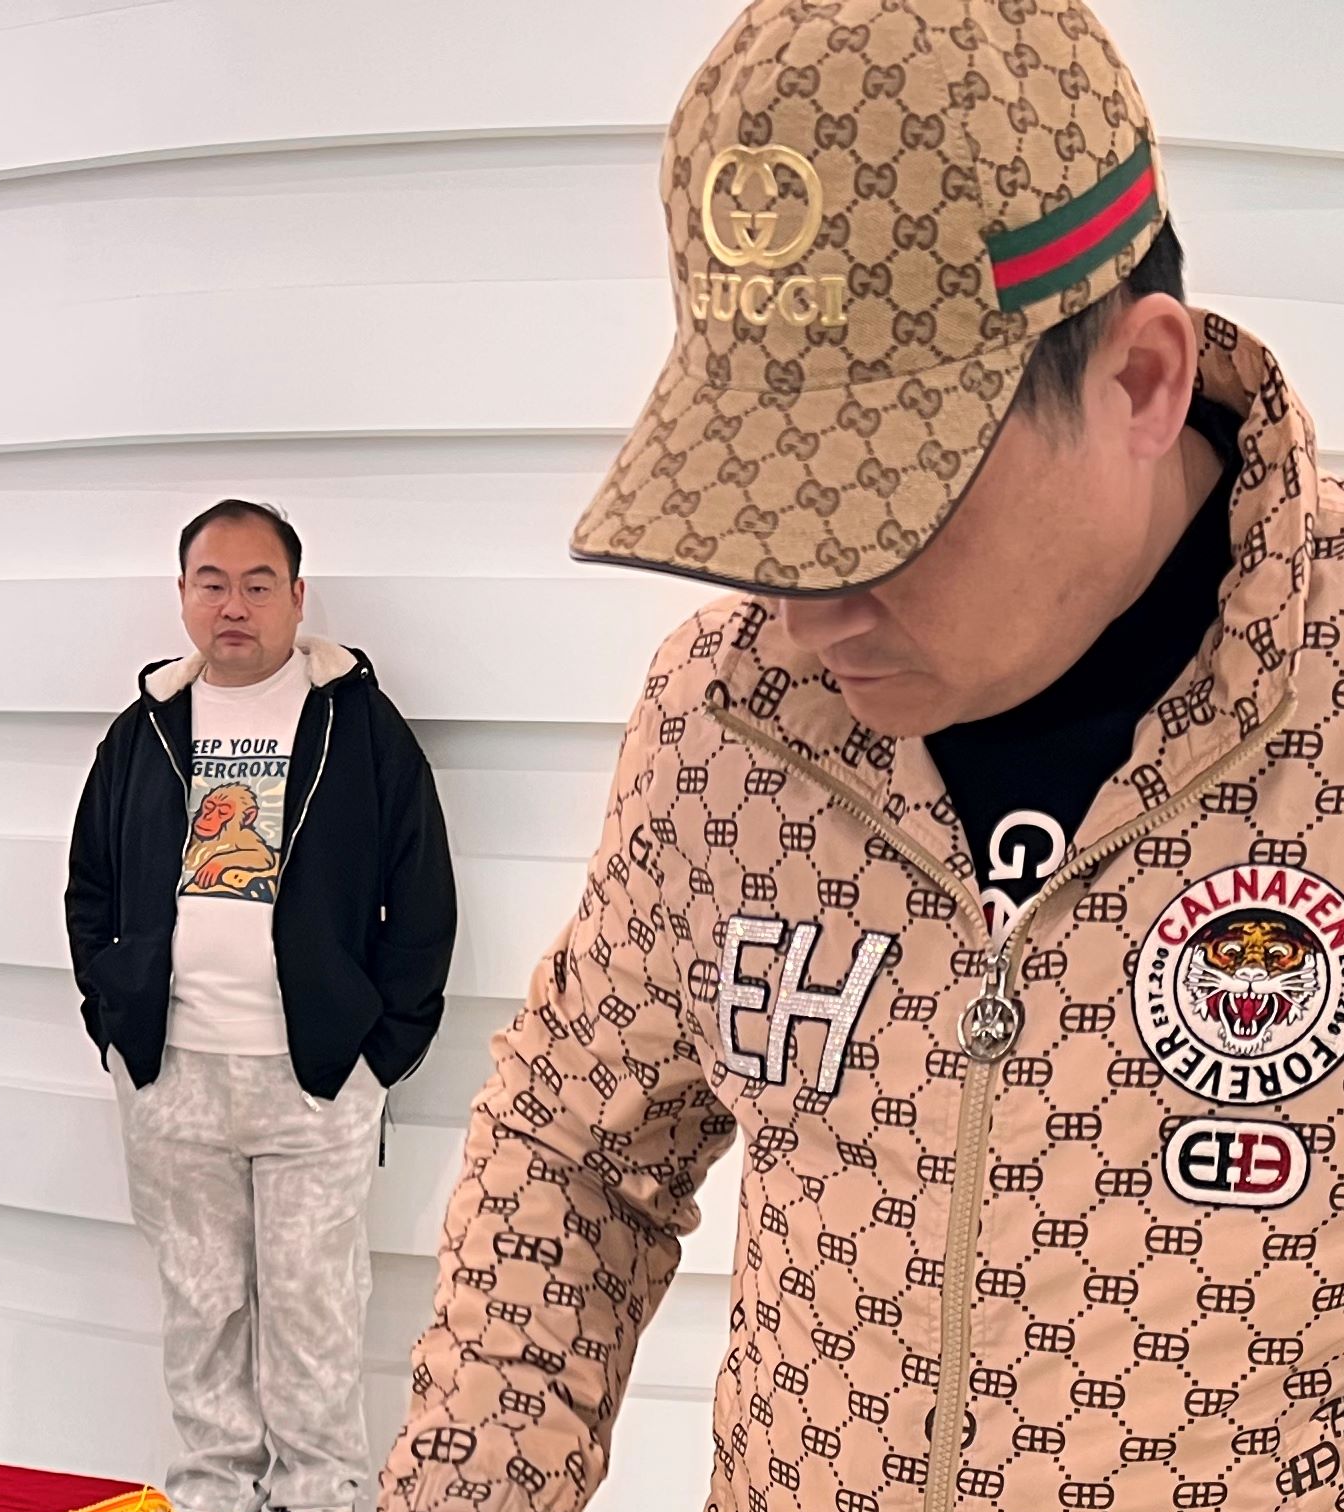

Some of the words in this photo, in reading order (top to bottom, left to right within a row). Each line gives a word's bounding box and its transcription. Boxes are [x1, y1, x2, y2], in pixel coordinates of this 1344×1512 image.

[691, 272, 848, 326] GUCCI
[229, 738, 278, 756] YOUR
[718, 914, 899, 1097] EH
[1155, 1025, 1338, 1100] FOREVER
